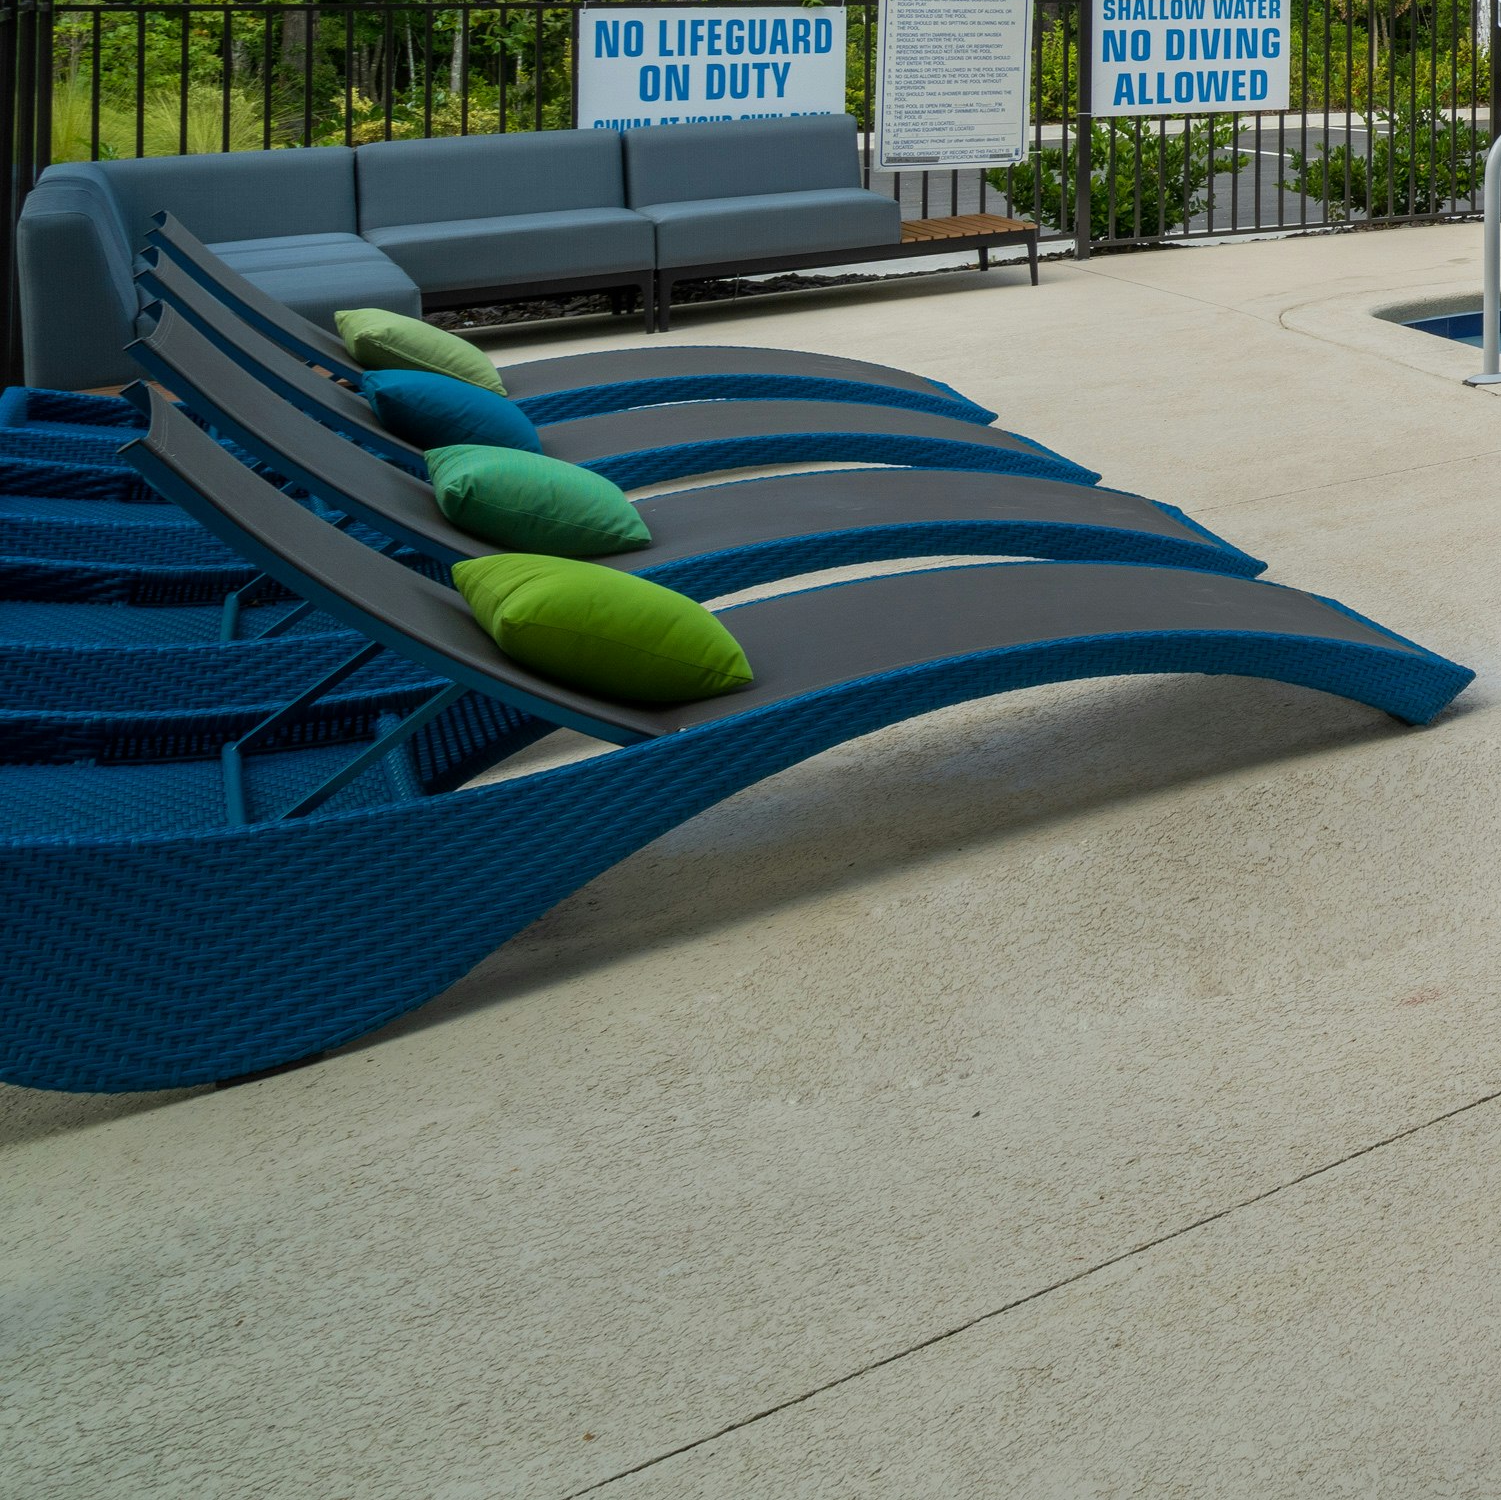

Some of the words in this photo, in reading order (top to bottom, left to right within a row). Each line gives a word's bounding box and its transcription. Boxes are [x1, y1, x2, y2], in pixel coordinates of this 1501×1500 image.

[594, 20, 644, 59] NO
[658, 18, 833, 57] LIFEGUARD
[1102, 29, 1151, 63] NO
[1165, 27, 1281, 61] DIVING
[639, 64, 690, 102] ON
[706, 61, 792, 100] DUTY
[1113, 69, 1268, 106] ALLOWED
